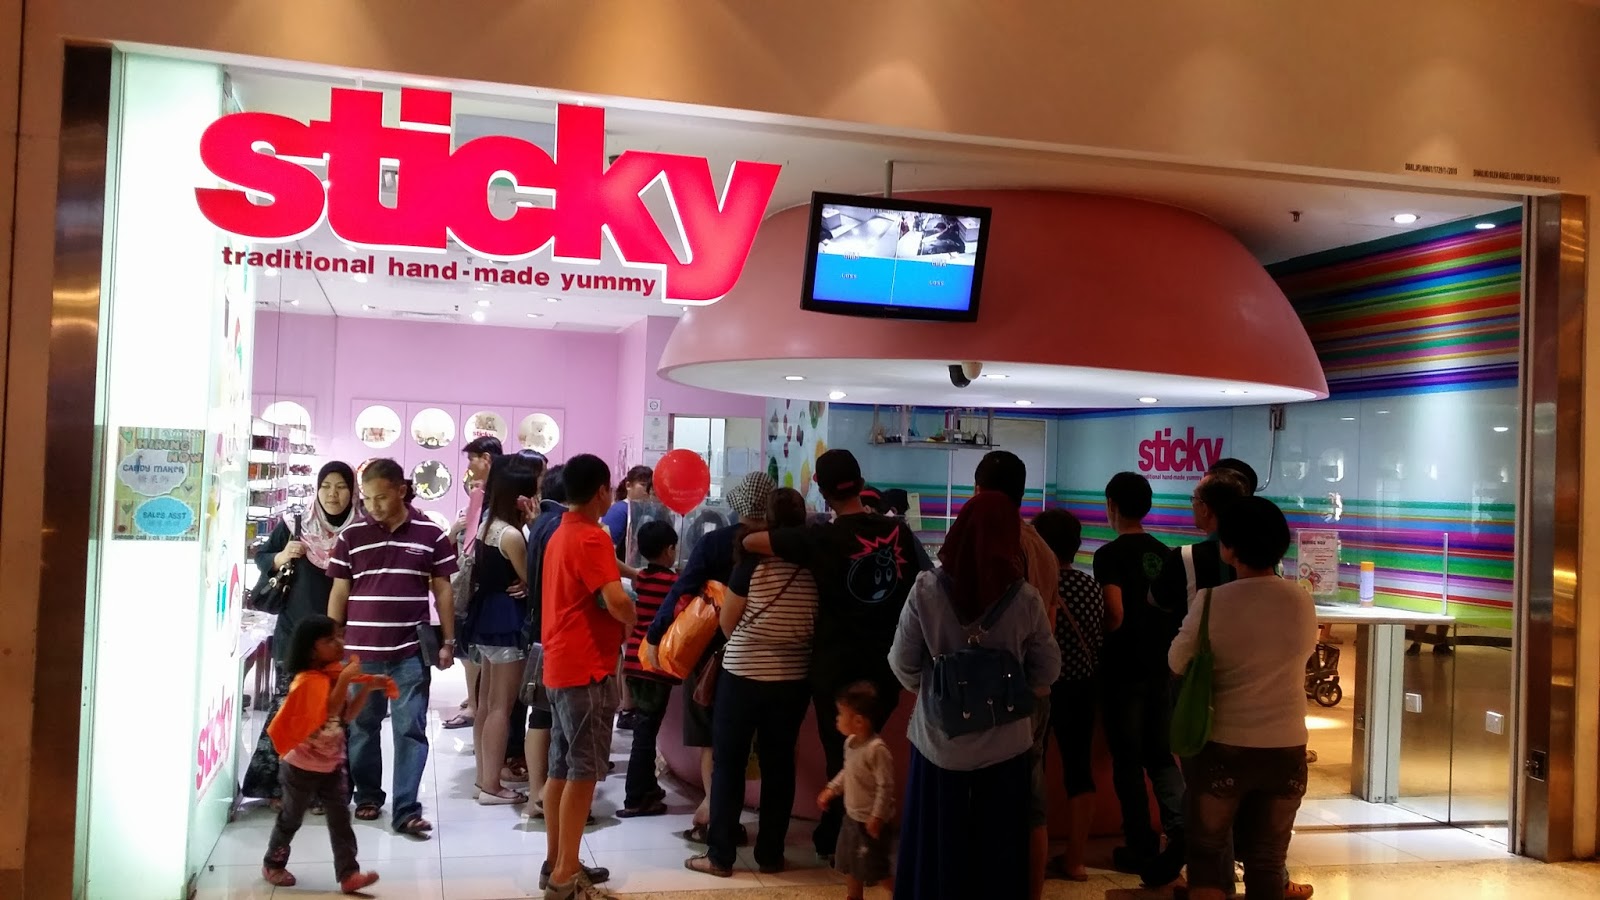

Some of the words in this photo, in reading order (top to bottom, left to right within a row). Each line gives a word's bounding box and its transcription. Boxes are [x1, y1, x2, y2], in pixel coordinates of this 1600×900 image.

[195, 88, 782, 303] sticky
[222, 245, 375, 274] traditional
[388, 255, 550, 286] hand-made
[561, 271, 656, 297] yummy
[137, 438, 190, 451] HIRING
[167, 451, 203, 463] NOW
[1138, 426, 1224, 476] sticky
